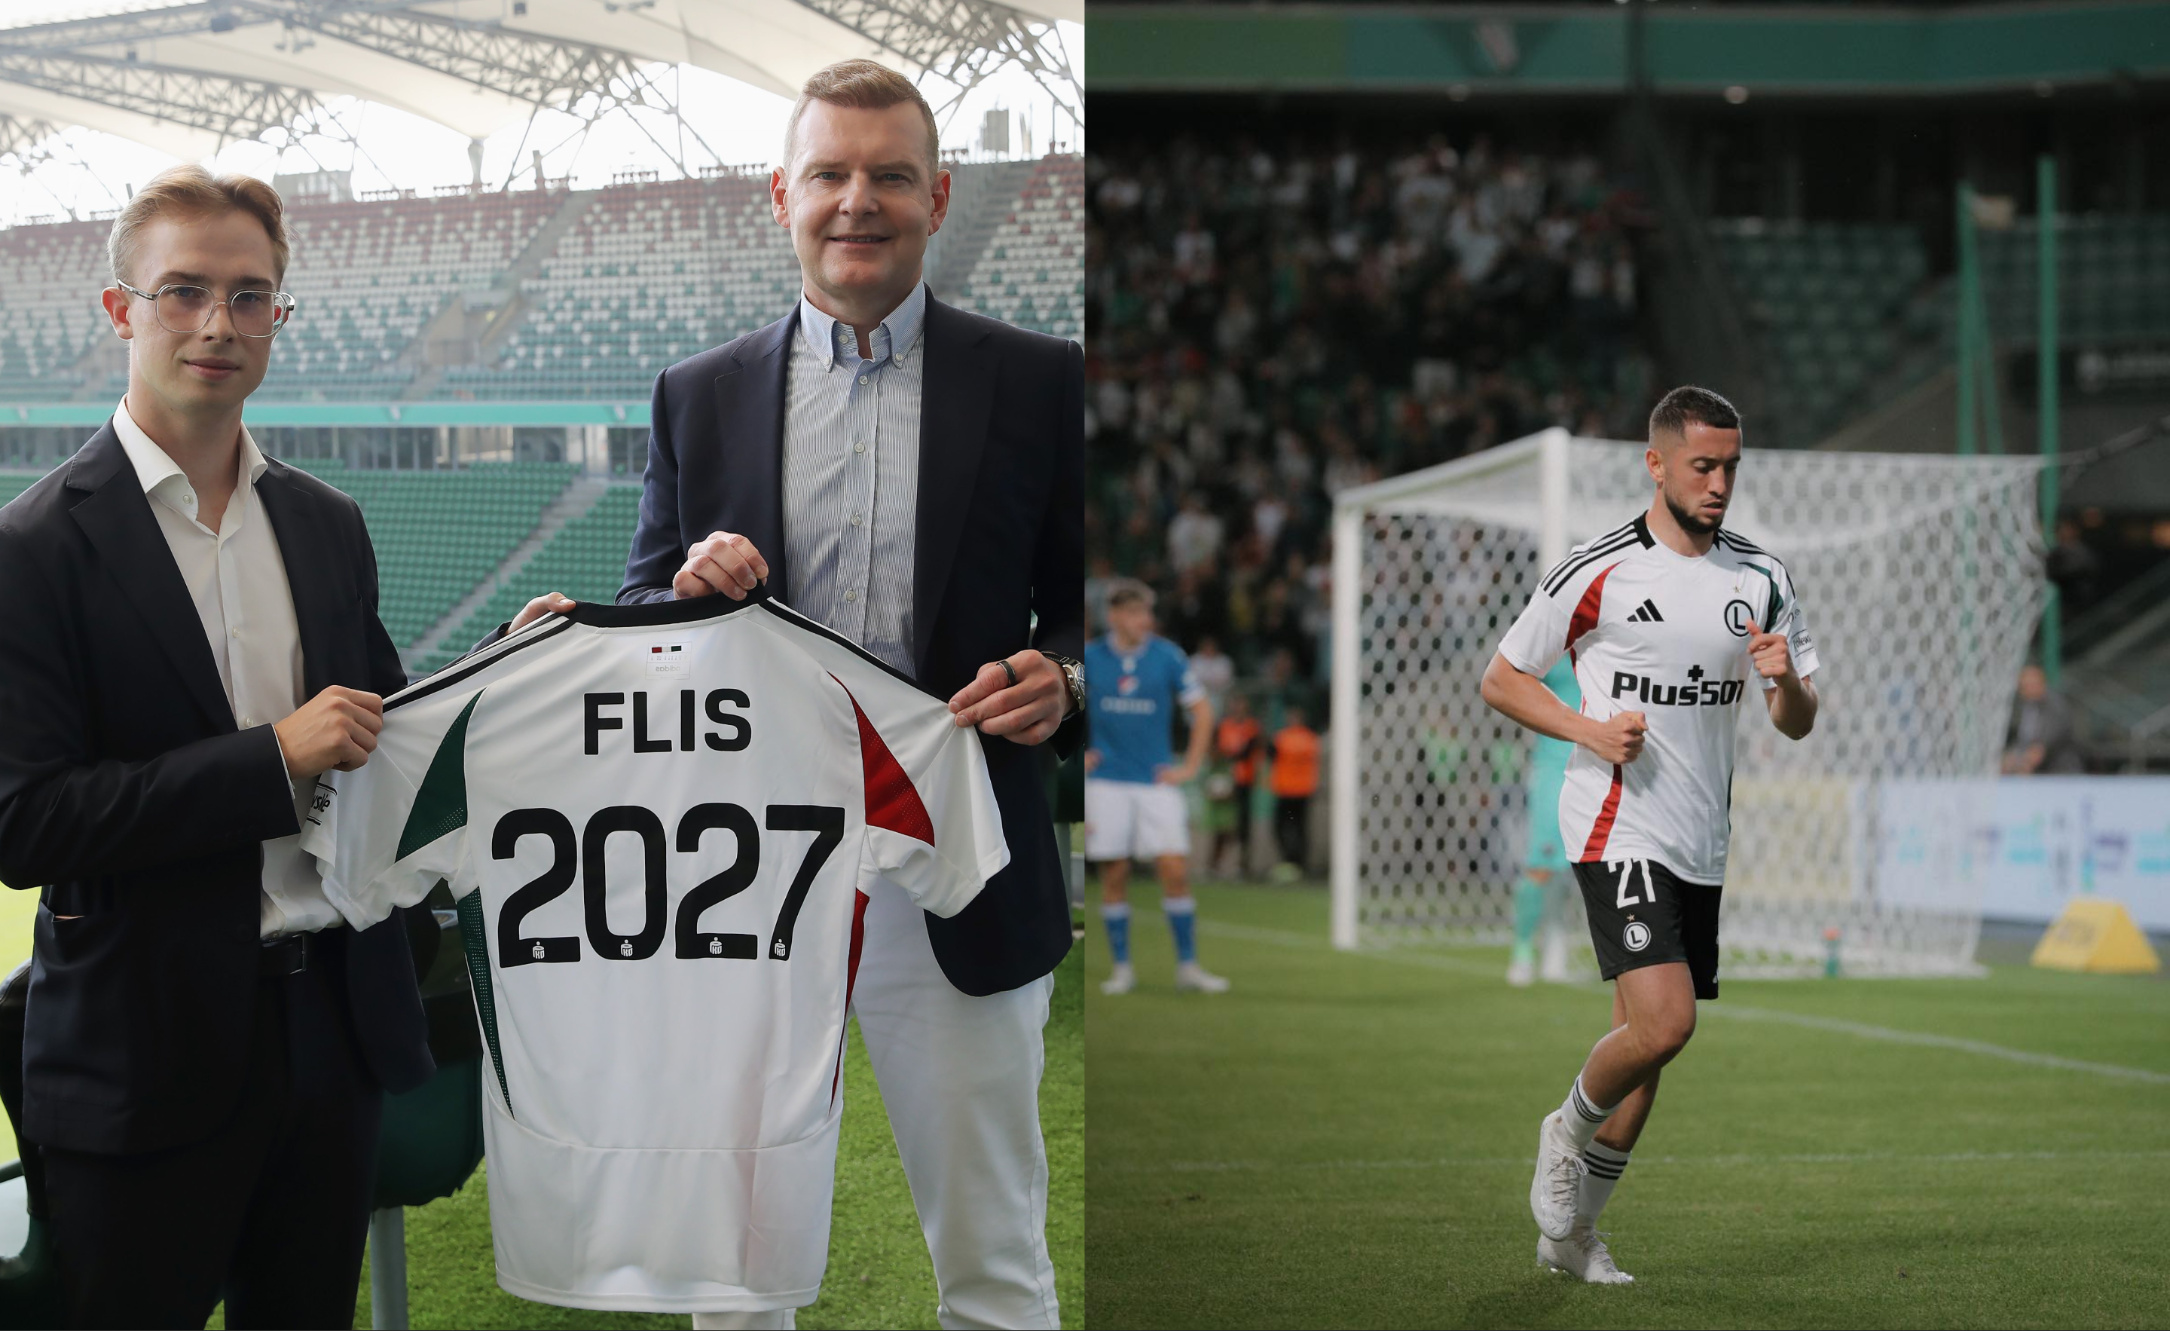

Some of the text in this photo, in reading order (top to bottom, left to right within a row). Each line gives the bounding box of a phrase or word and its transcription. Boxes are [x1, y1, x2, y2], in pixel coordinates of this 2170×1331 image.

[584, 688, 752, 755] FLIS
[492, 802, 845, 969] 2027
[1607, 858, 1656, 909] 21
